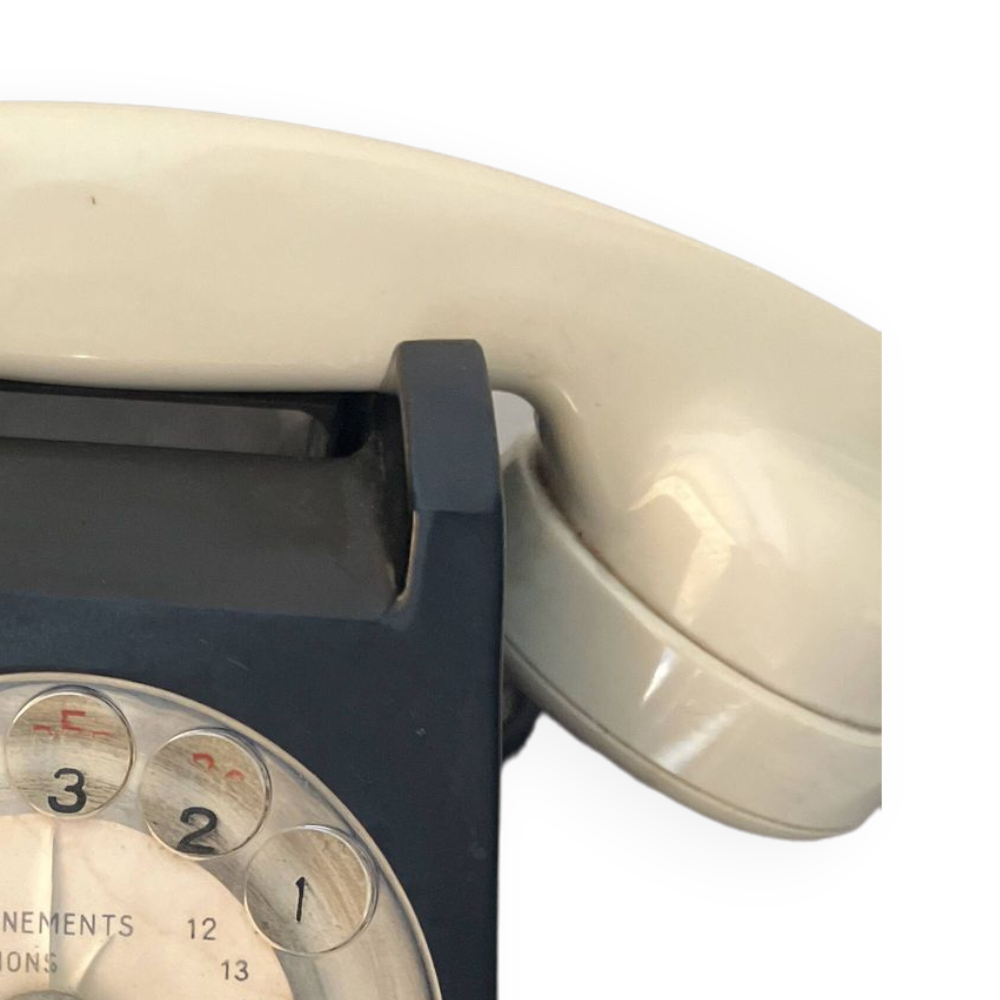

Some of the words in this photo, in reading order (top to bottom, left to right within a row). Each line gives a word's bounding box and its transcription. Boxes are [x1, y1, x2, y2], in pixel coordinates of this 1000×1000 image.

[47, 767, 87, 814] 3
[176, 806, 217, 855] 2
[295, 876, 305, 922] 1
[187, 917, 217, 941] 12
[221, 959, 249, 982] 13
